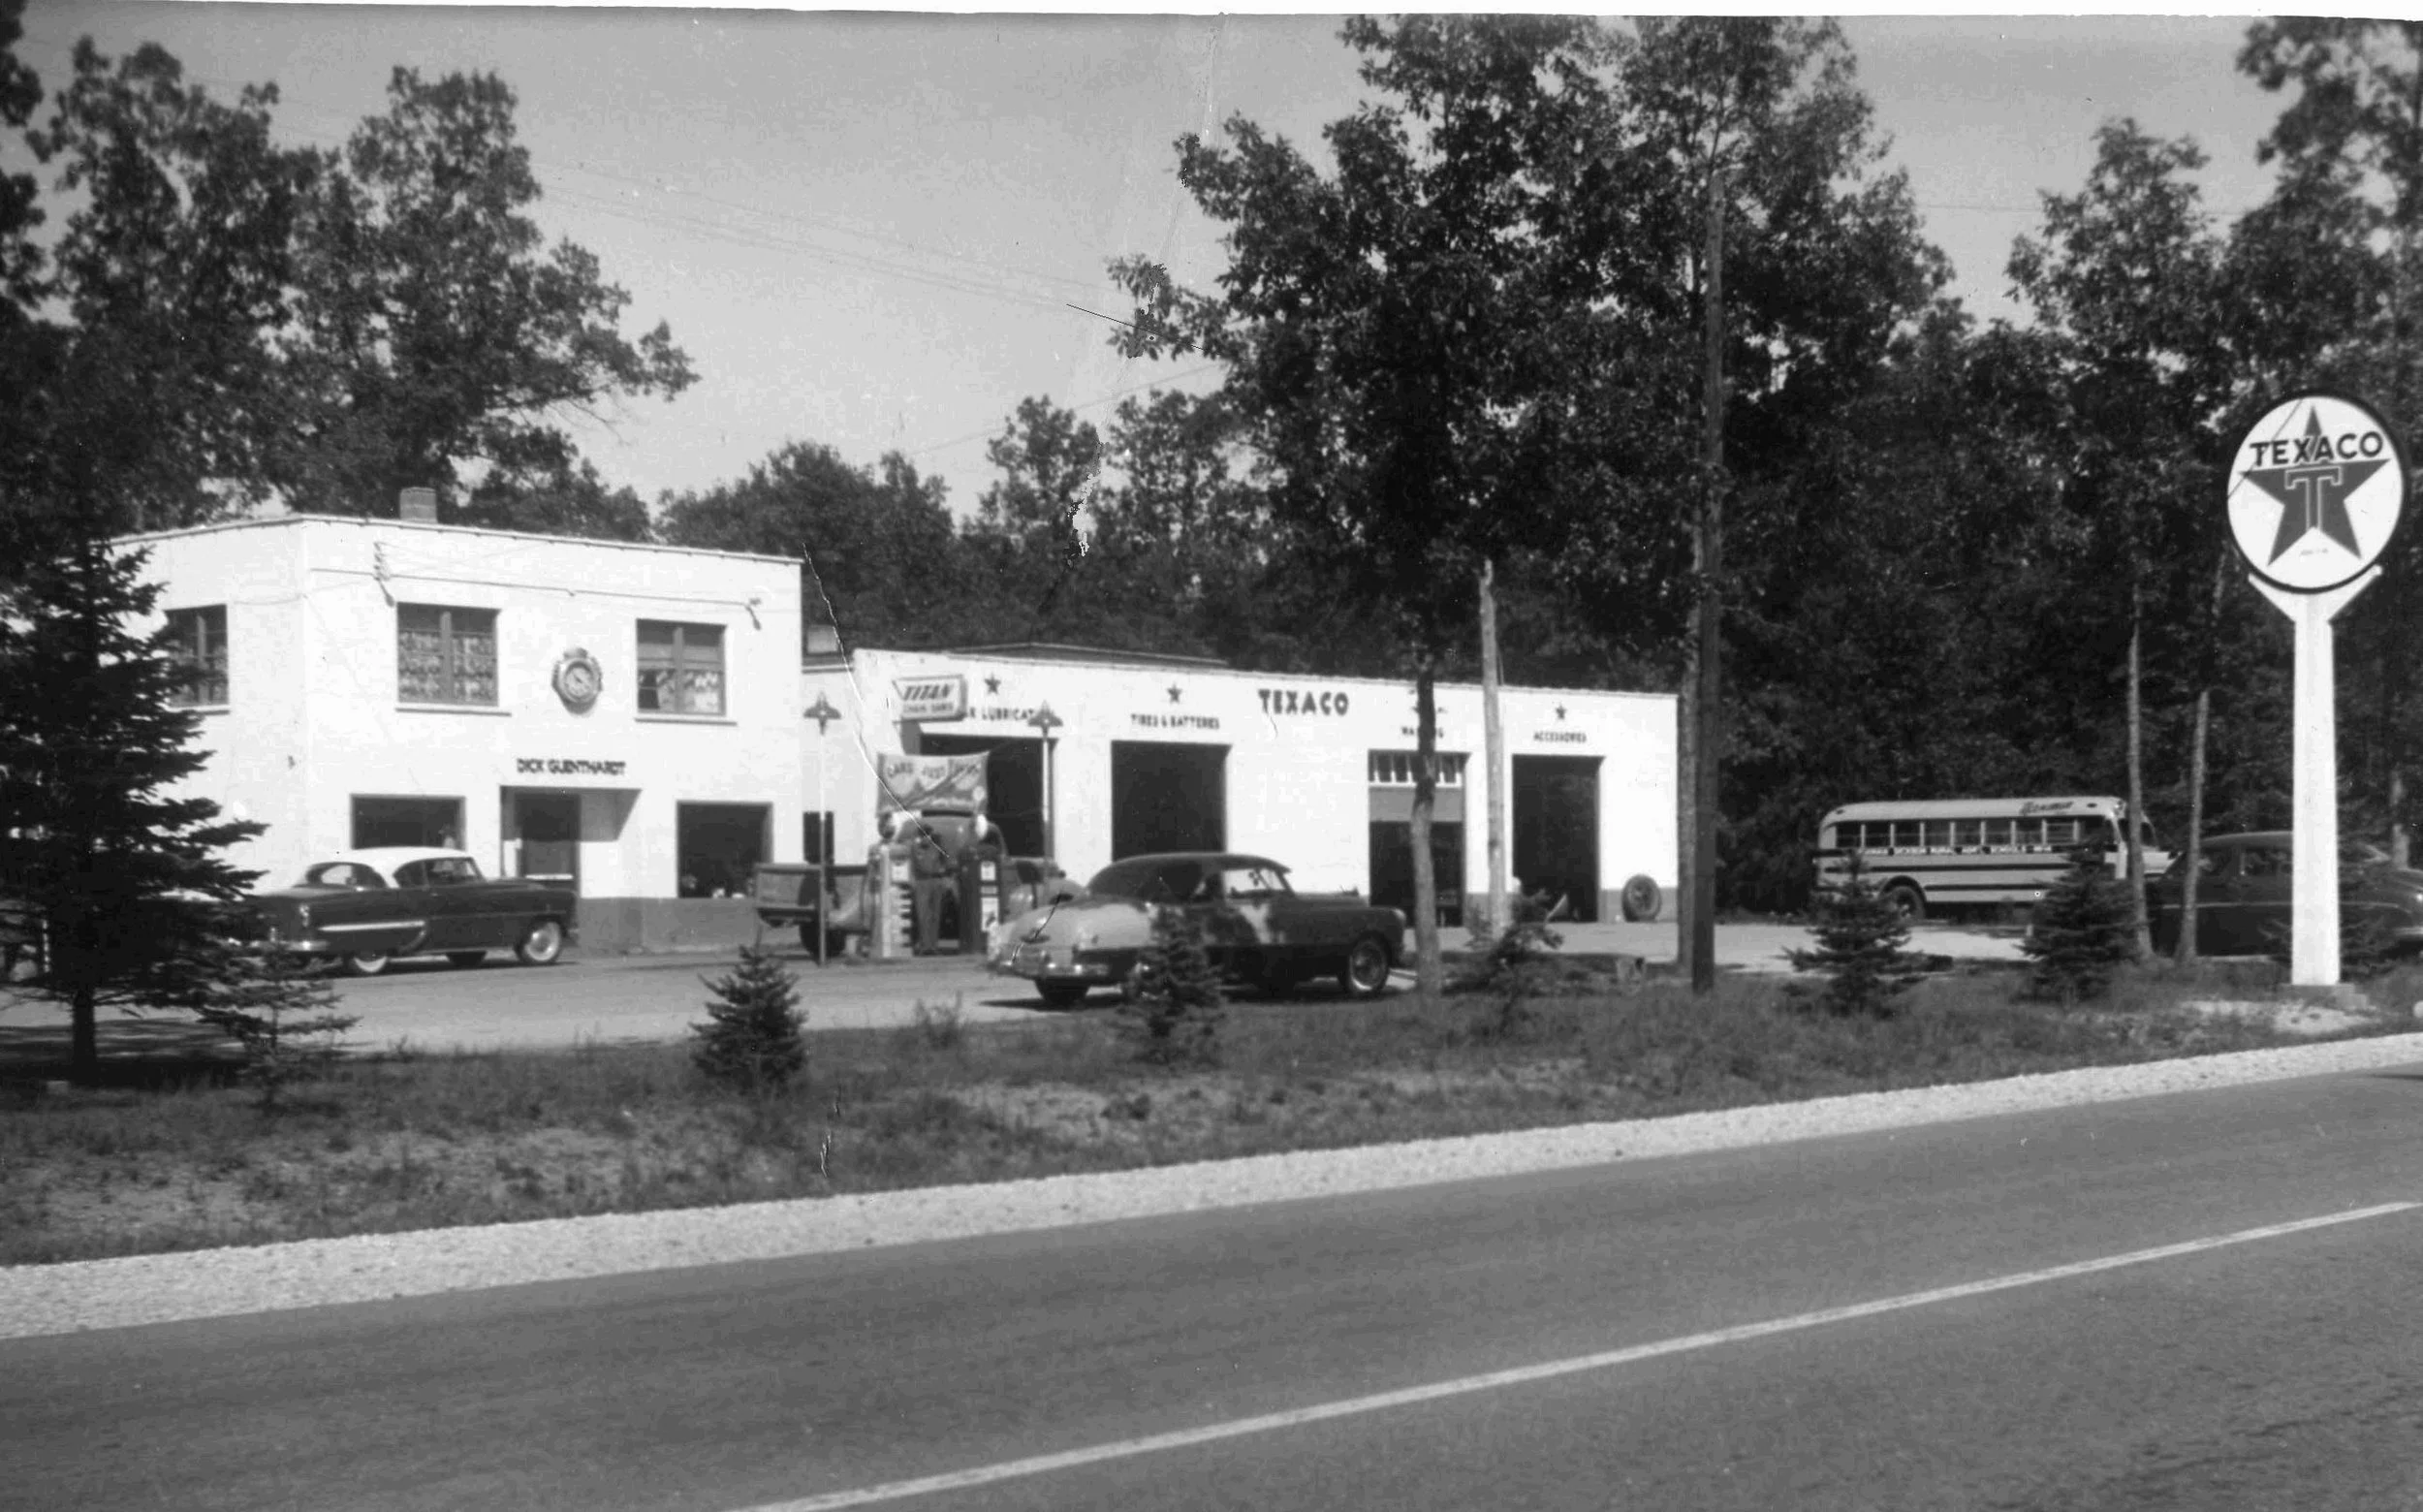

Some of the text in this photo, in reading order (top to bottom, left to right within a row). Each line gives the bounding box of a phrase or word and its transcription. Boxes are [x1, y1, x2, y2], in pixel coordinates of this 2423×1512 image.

[2249, 430, 2383, 466] TEXACO
[1258, 688, 1349, 715] TEXACO
[982, 707, 1034, 721] LUBRICAT
[1131, 712, 1158, 727] TIRES
[517, 758, 544, 773] DICK
